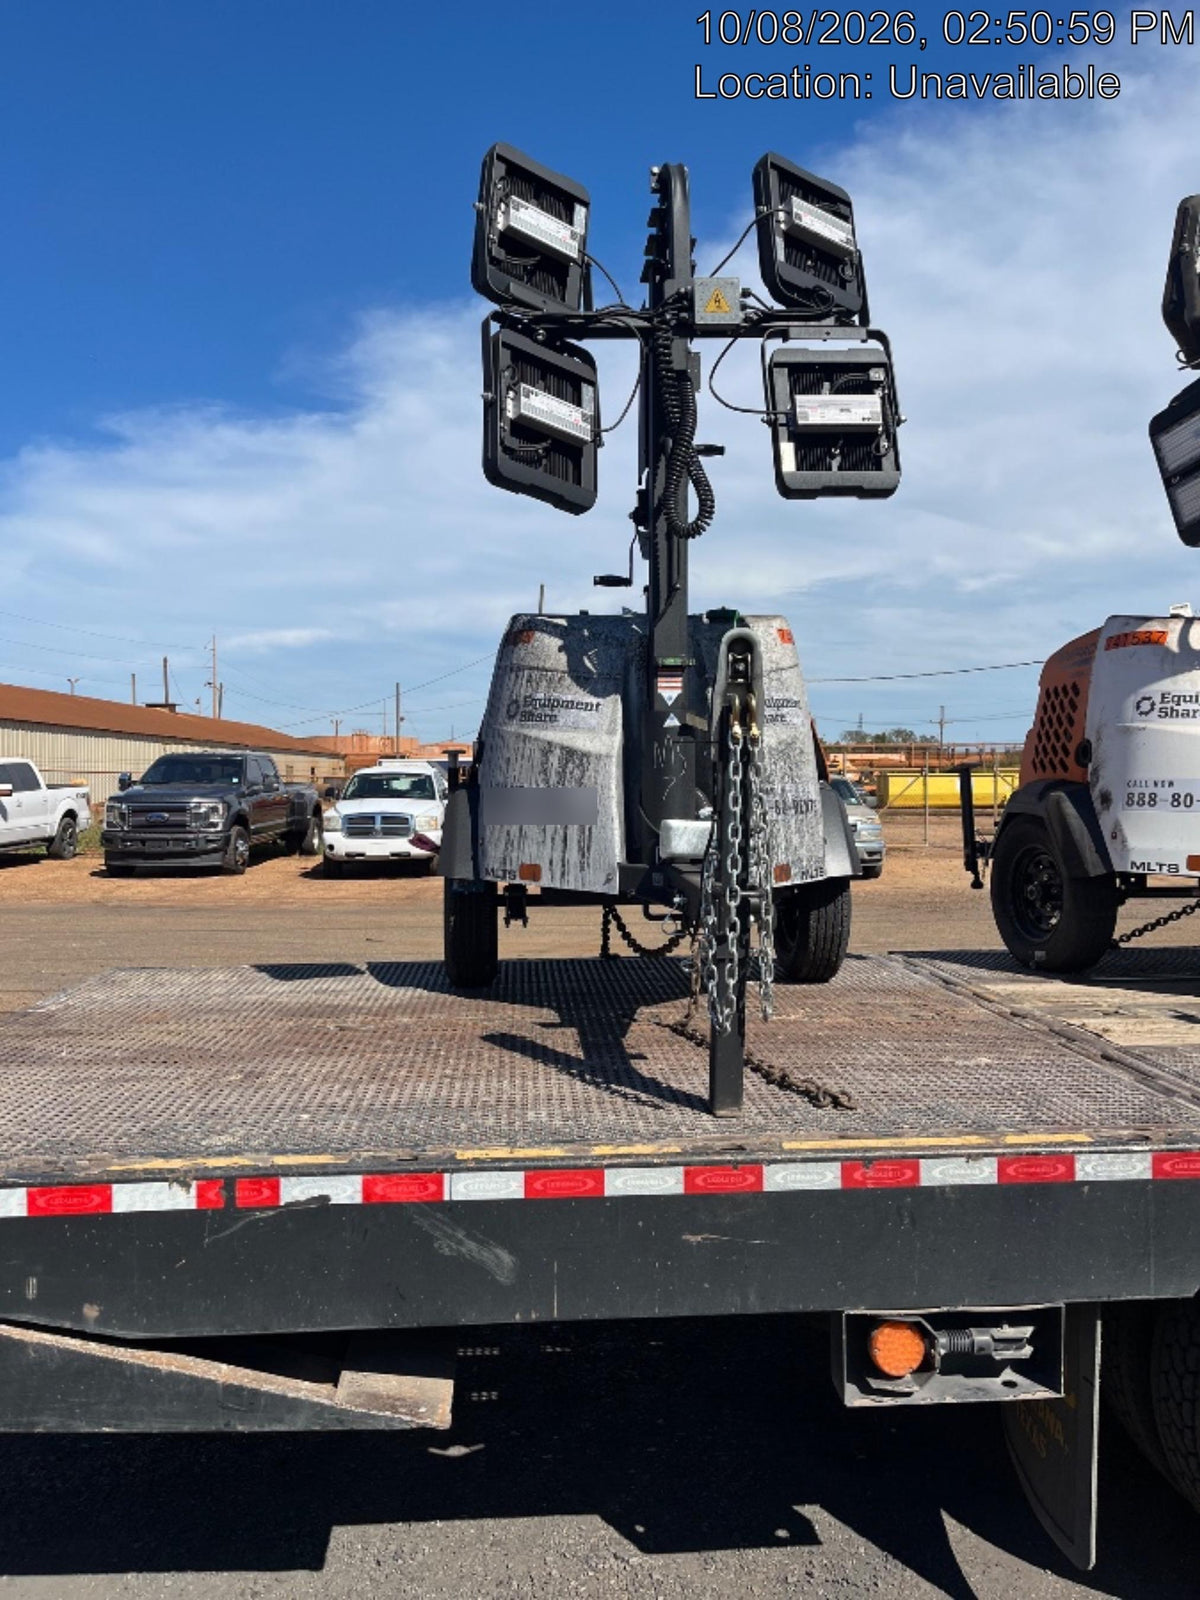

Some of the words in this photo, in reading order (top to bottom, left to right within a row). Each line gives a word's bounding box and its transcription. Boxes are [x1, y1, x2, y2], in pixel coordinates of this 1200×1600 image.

[523, 694, 602, 712] Equipment
[1159, 692, 1200, 706] Equi
[519, 710, 558, 722] Share
[1157, 706, 1200, 718] Shar
[1126, 779, 1149, 788] CALL
[1153, 779, 1175, 788] NOW
[1130, 861, 1179, 873] MLTS
